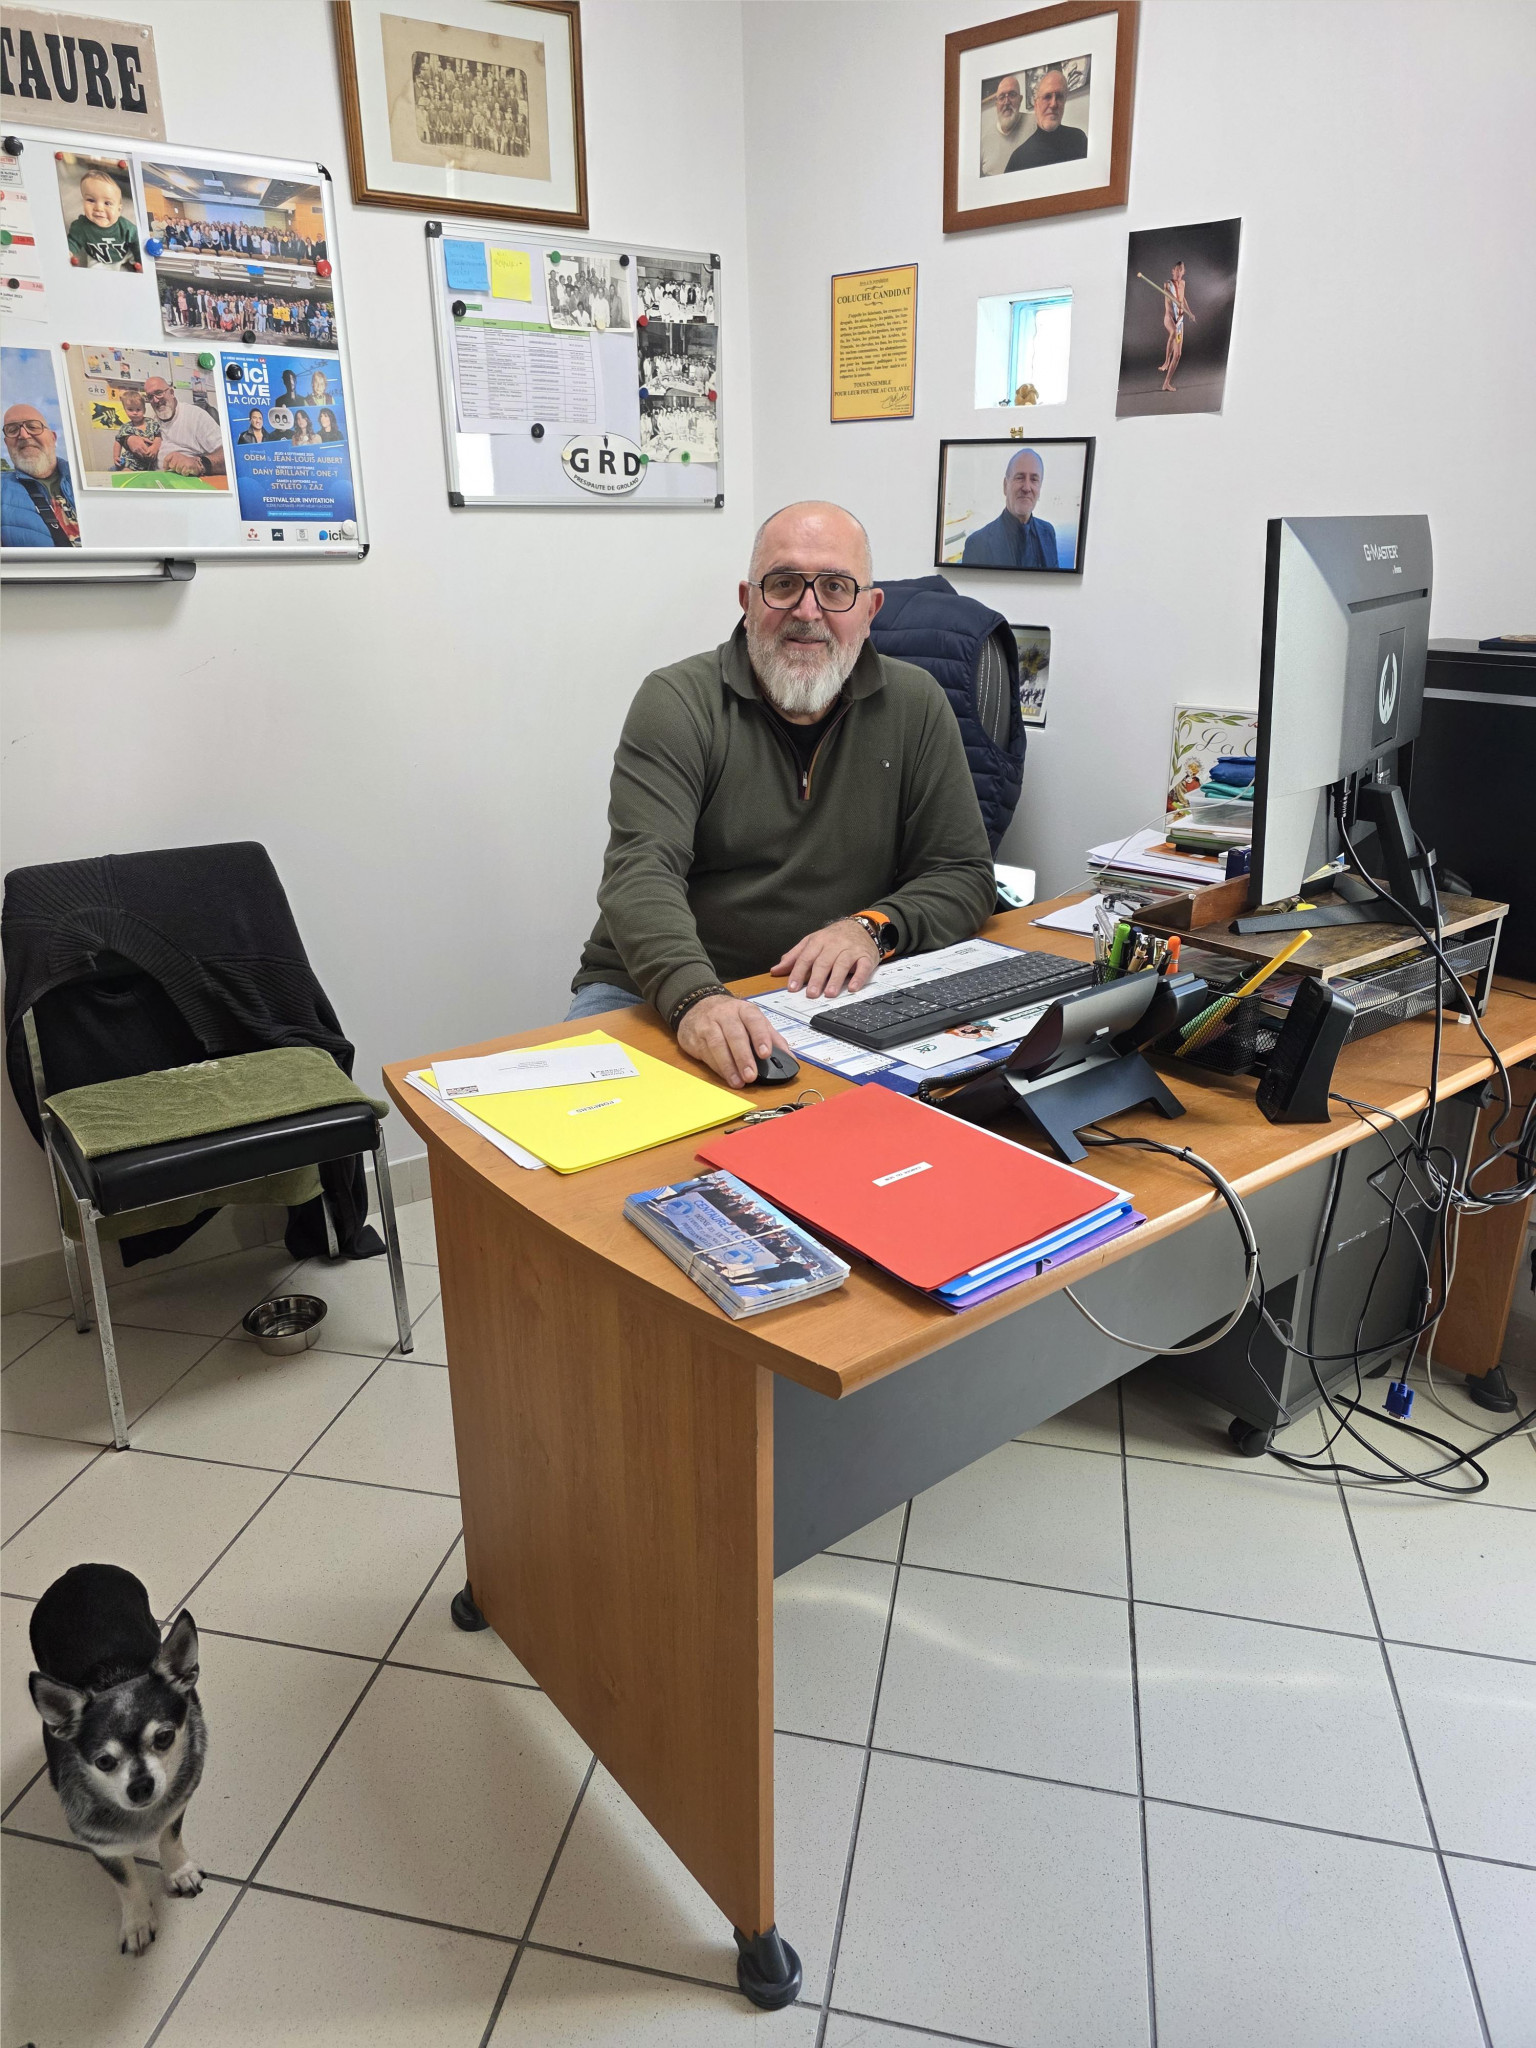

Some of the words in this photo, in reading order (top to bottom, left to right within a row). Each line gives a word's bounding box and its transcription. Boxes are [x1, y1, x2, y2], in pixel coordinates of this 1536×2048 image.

[837, 293, 871, 304] COLUCHE
[873, 287, 911, 299] CANDIDAT
[226, 383, 270, 397] LIVE
[228, 397, 240, 405] LA
[241, 397, 271, 406] CIOTAT
[273, 455, 315, 463] JEAN-LOUIS
[617, 477, 639, 490] GROLAND
[1363, 543, 1398, 563] G-MASTER
[1196, 727, 1235, 755] La
[694, 1199, 731, 1229] CENTAURE
[723, 1223, 737, 1236] LA
[737, 1232, 765, 1254] COTAT
